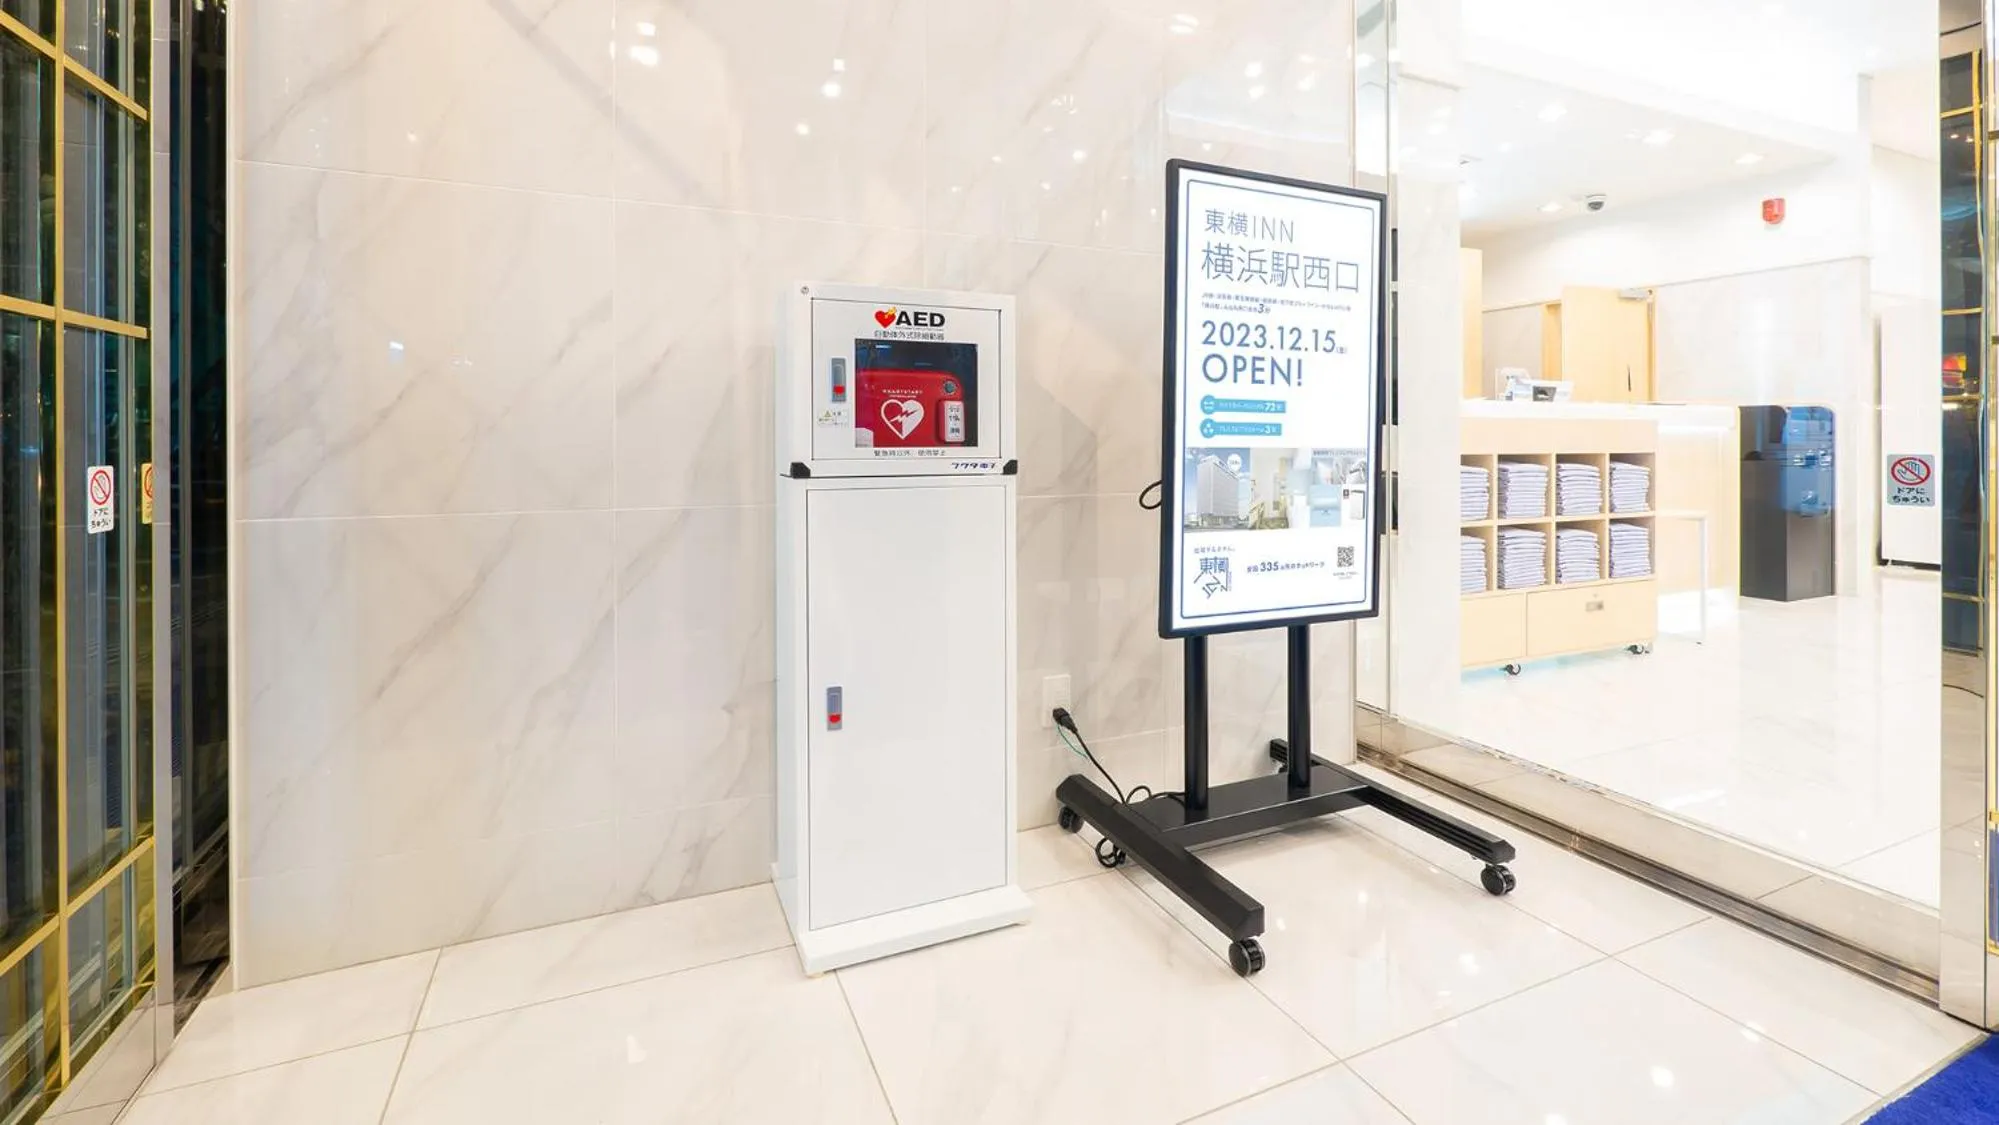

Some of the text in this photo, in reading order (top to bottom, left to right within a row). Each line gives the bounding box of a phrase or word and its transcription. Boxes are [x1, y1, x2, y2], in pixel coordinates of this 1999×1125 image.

[1204, 208, 1295, 243] 東横INN
[1201, 241, 1359, 293] 横浜駅西口
[896, 310, 946, 327] AED
[1202, 320, 1337, 353] 2023.12.15
[1202, 353, 1303, 387] OPEN!
[1892, 495, 1930, 503] ちゅうい
